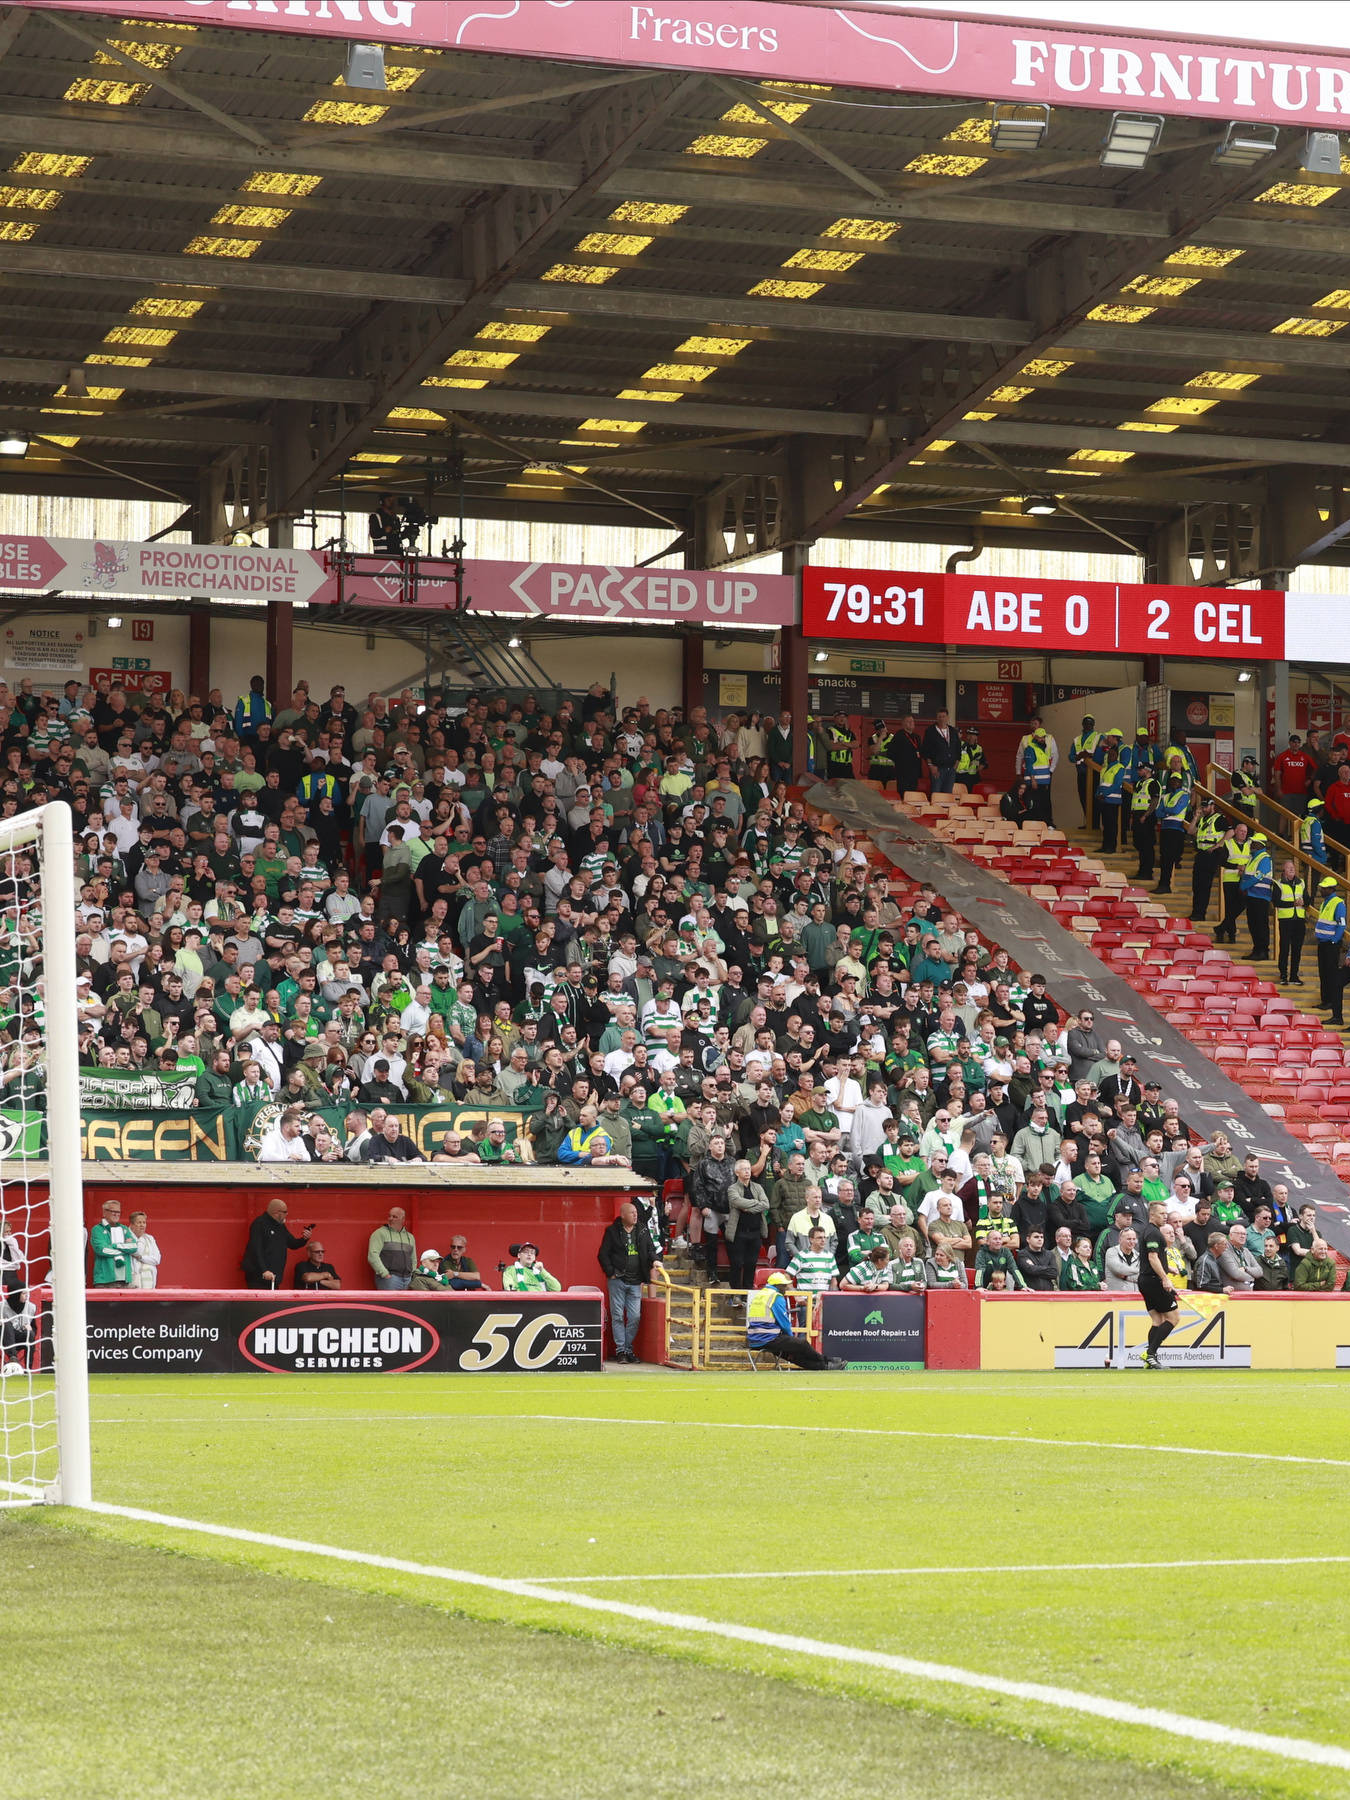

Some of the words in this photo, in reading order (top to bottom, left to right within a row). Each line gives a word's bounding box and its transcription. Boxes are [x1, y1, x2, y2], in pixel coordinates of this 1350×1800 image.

[629, 6, 779, 54] Frasers
[139, 550, 299, 575] PROMOTIONAL
[141, 570, 297, 593] MERCHANDISE
[550, 568, 697, 616] PACKED
[707, 580, 758, 614] UP
[823, 583, 924, 626] 79:31
[966, 590, 1043, 634] ABE
[1066, 595, 1089, 636] 0
[134, 622, 150, 638] 19
[1147, 600, 1170, 640] 2
[1193, 602, 1262, 644] CEL
[30, 630, 60, 638] NOTICE
[1000, 663, 1020, 678] 20
[763, 675, 781, 685] dri
[817, 677, 857, 688] snacks
[958, 685, 965, 695] 8
[1058, 689, 1064, 699] 8
[85, 1325, 155, 1341] Complete
[159, 1325, 219, 1341] Building
[254, 1327, 422, 1354] HUTCHEON
[553, 1328, 584, 1338] YEARS
[459, 1313, 569, 1371] 50
[567, 1343, 586, 1352] 1974
[87, 1346, 128, 1360] rvices
[132, 1346, 203, 1363] Company
[295, 1356, 383, 1368] SERVICES
[557, 1357, 577, 1366] 2024
[1157, 1352, 1183, 1360] atforms
[1184, 1352, 1214, 1360] Aberdeen
